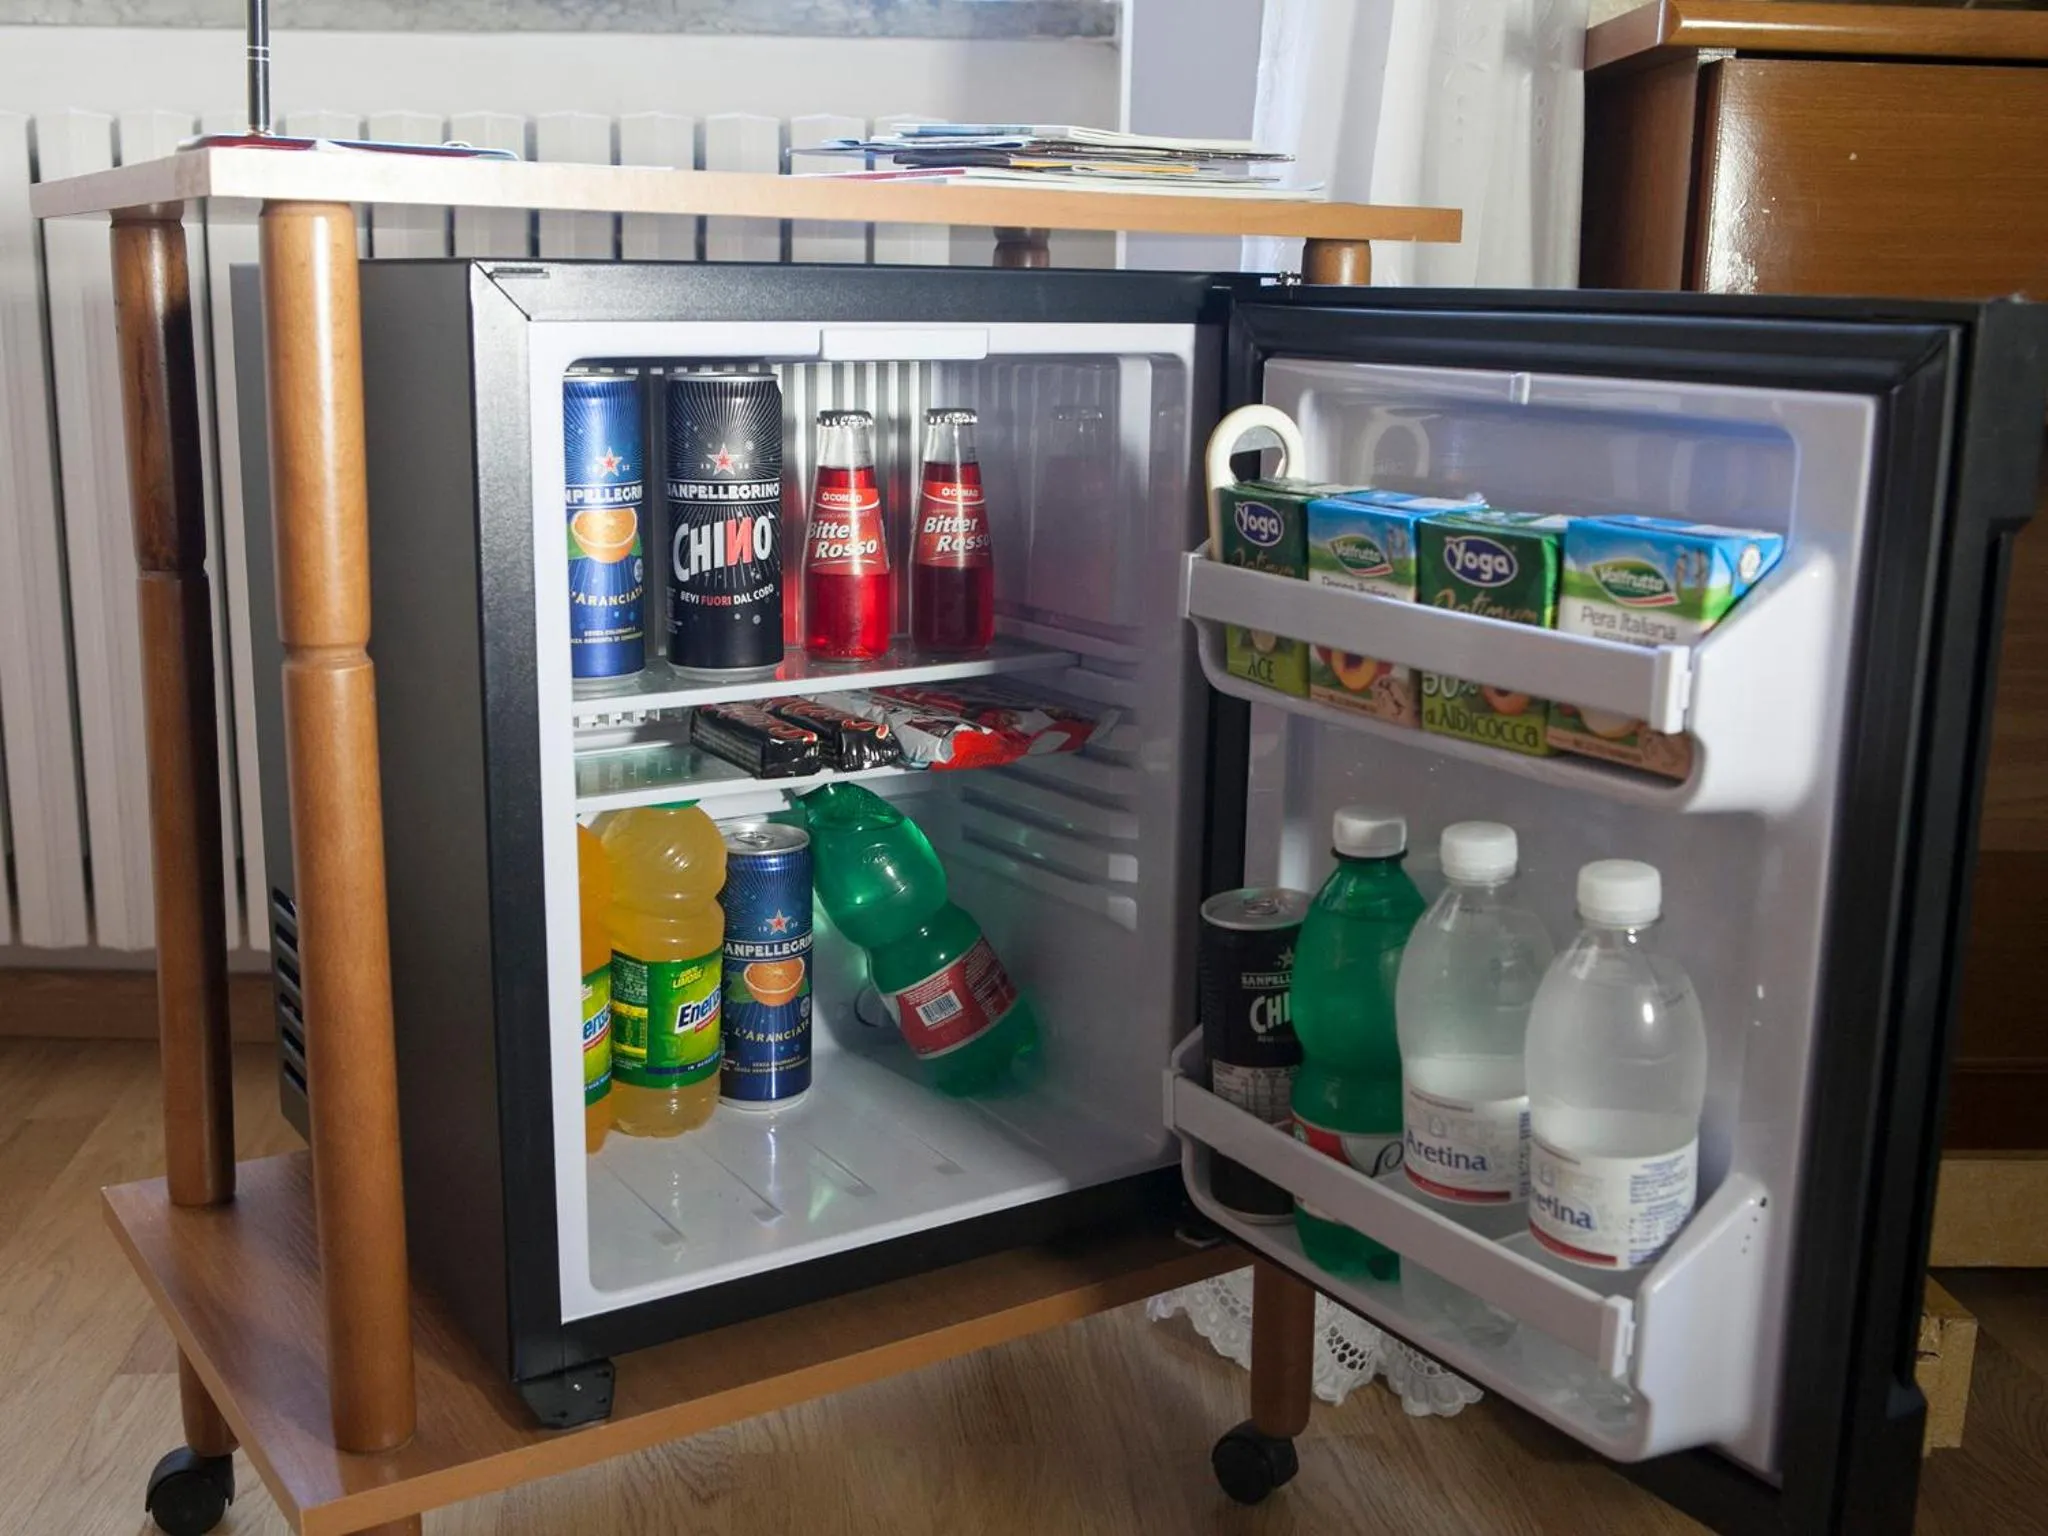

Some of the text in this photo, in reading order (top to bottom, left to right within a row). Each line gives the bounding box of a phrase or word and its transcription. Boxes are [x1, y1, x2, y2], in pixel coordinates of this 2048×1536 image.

[807, 520, 858, 539] Bitte
[923, 514, 979, 533] Bitter
[1238, 506, 1279, 540] Yoga
[815, 540, 878, 558] Rosso
[1449, 541, 1511, 581] Yoga
[701, 594, 732, 606] FUORI
[733, 592, 753, 605] DAL
[1582, 605, 1616, 630] Pera
[1619, 613, 1677, 641] Italiana
[1247, 657, 1276, 683] ACE
[1249, 991, 1291, 1034] CHI
[1405, 1129, 1488, 1172] Aretina
